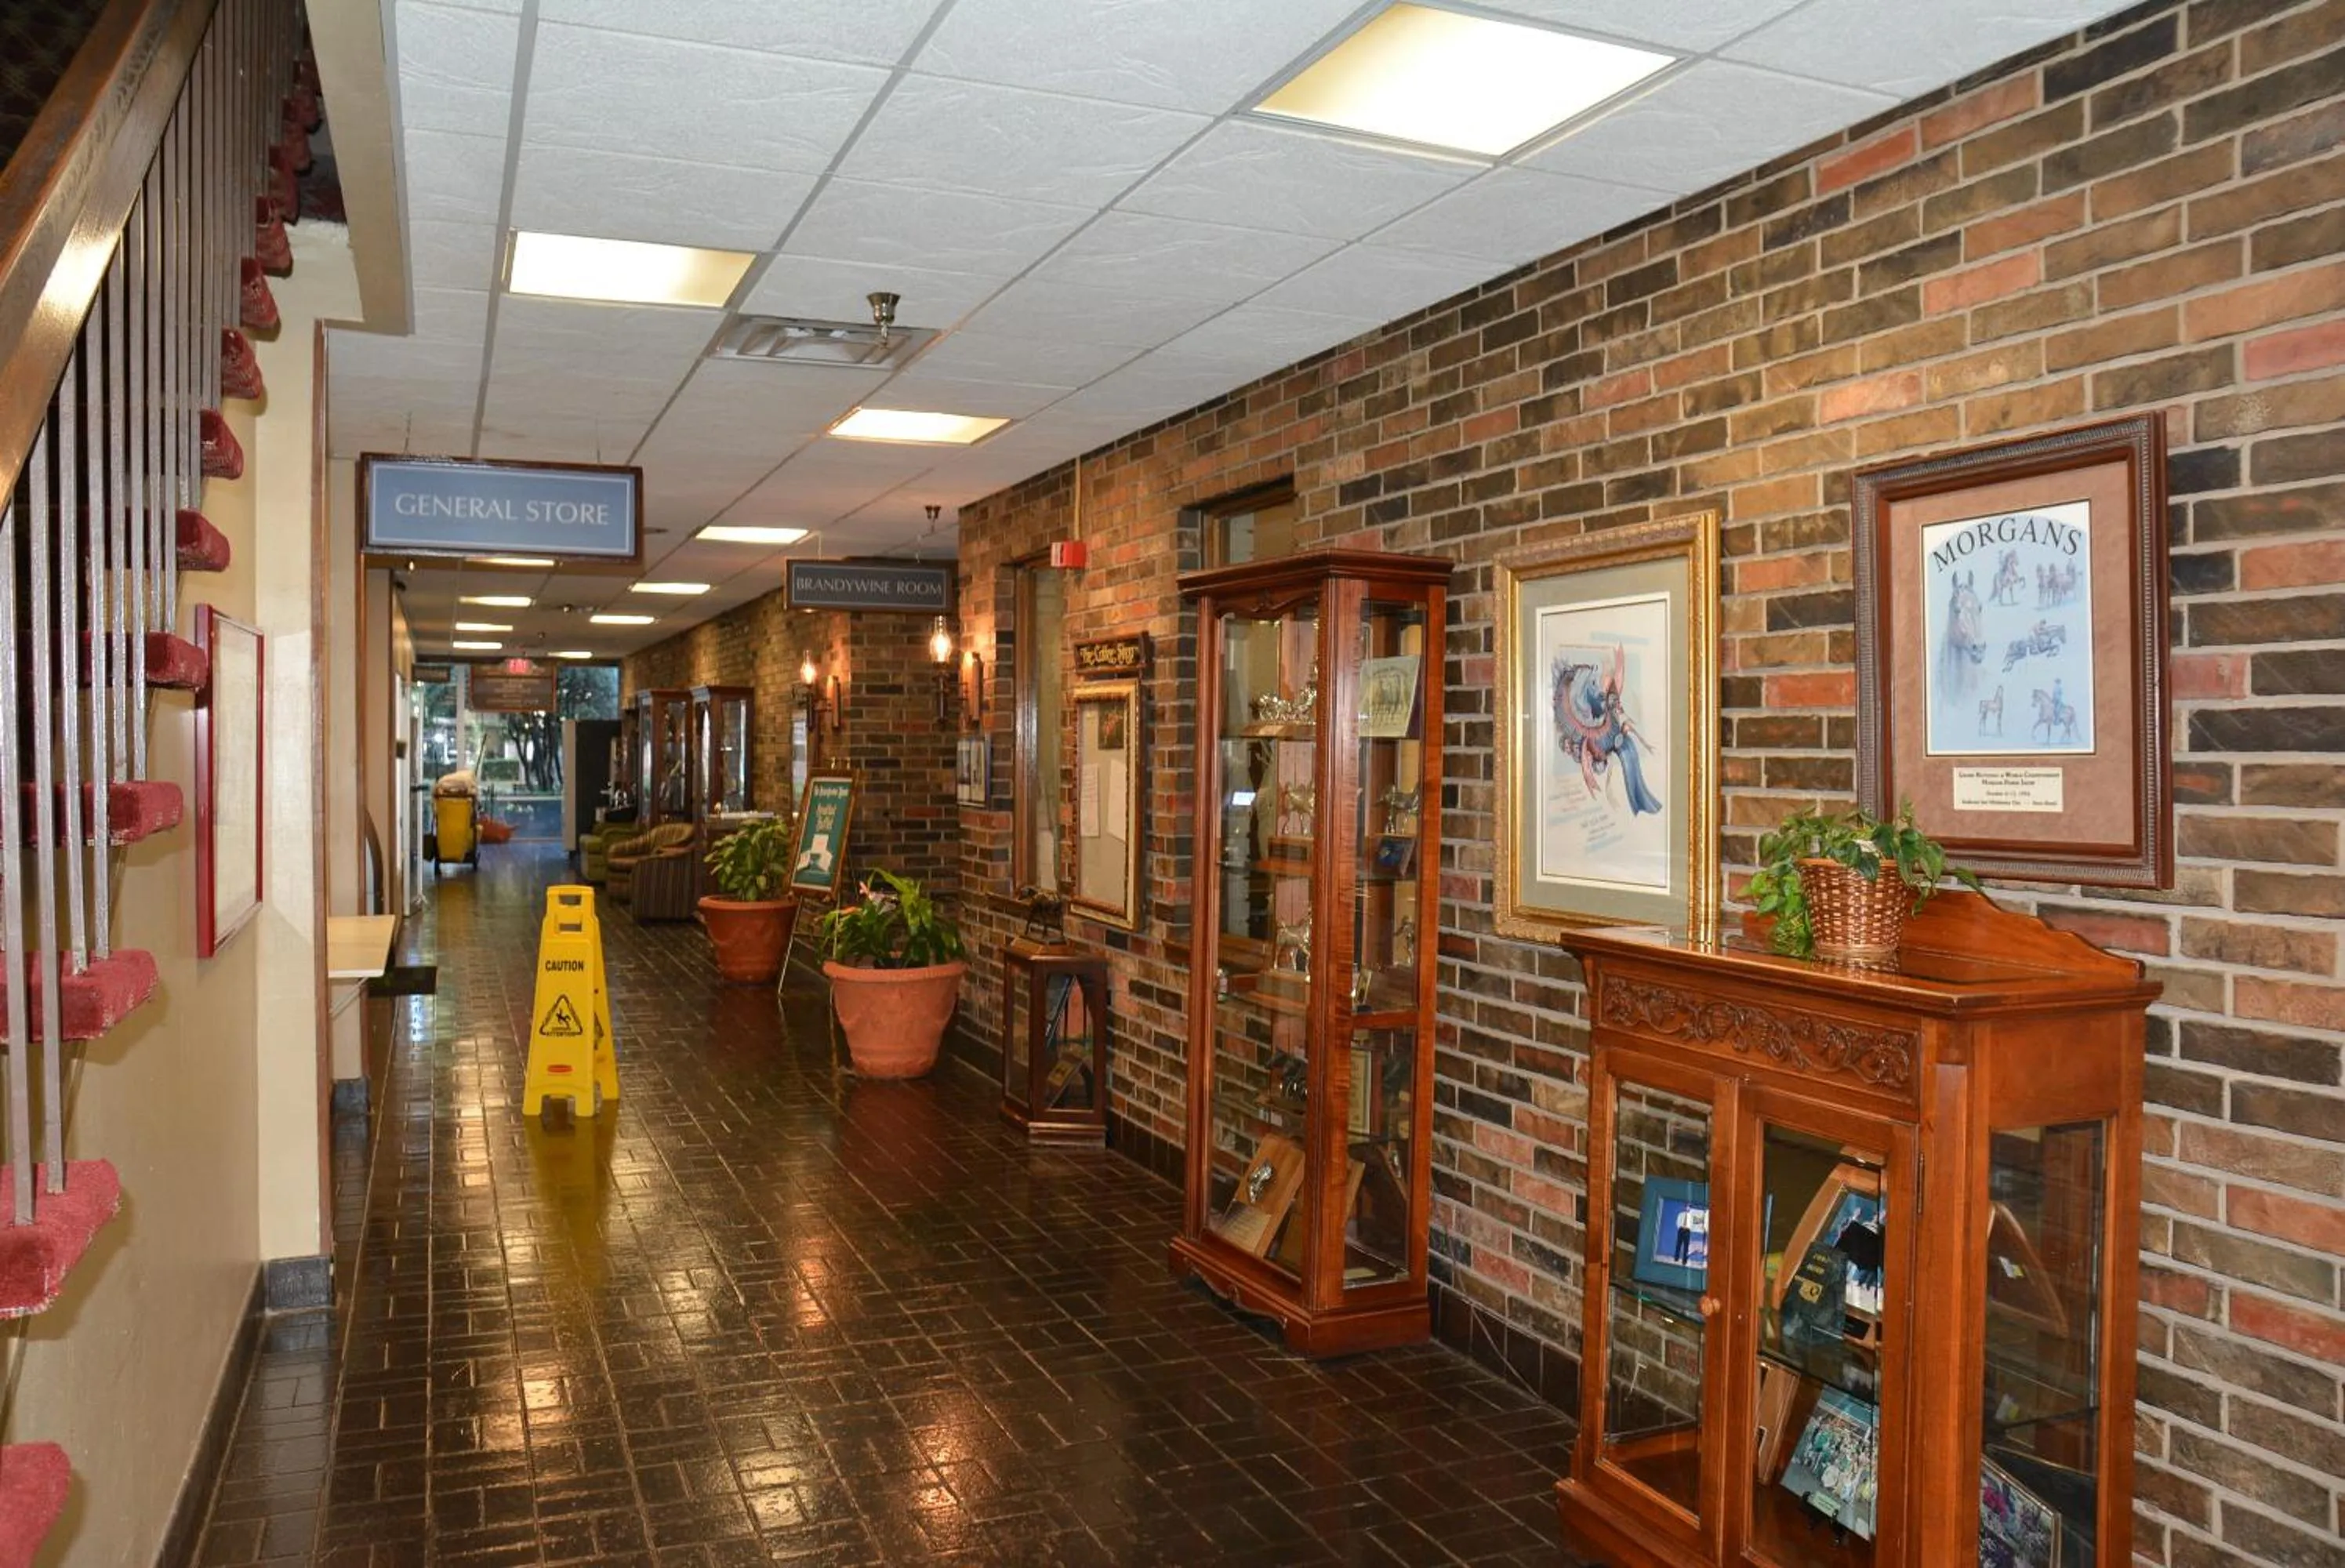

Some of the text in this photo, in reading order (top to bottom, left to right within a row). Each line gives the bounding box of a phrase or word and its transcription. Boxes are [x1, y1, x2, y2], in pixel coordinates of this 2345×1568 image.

[395, 493, 609, 524] GENERAL STORE
[1933, 517, 2082, 572] MORGANS
[797, 576, 942, 596] BRANDYWINE ROOM
[545, 960, 584, 971] CAUTION
